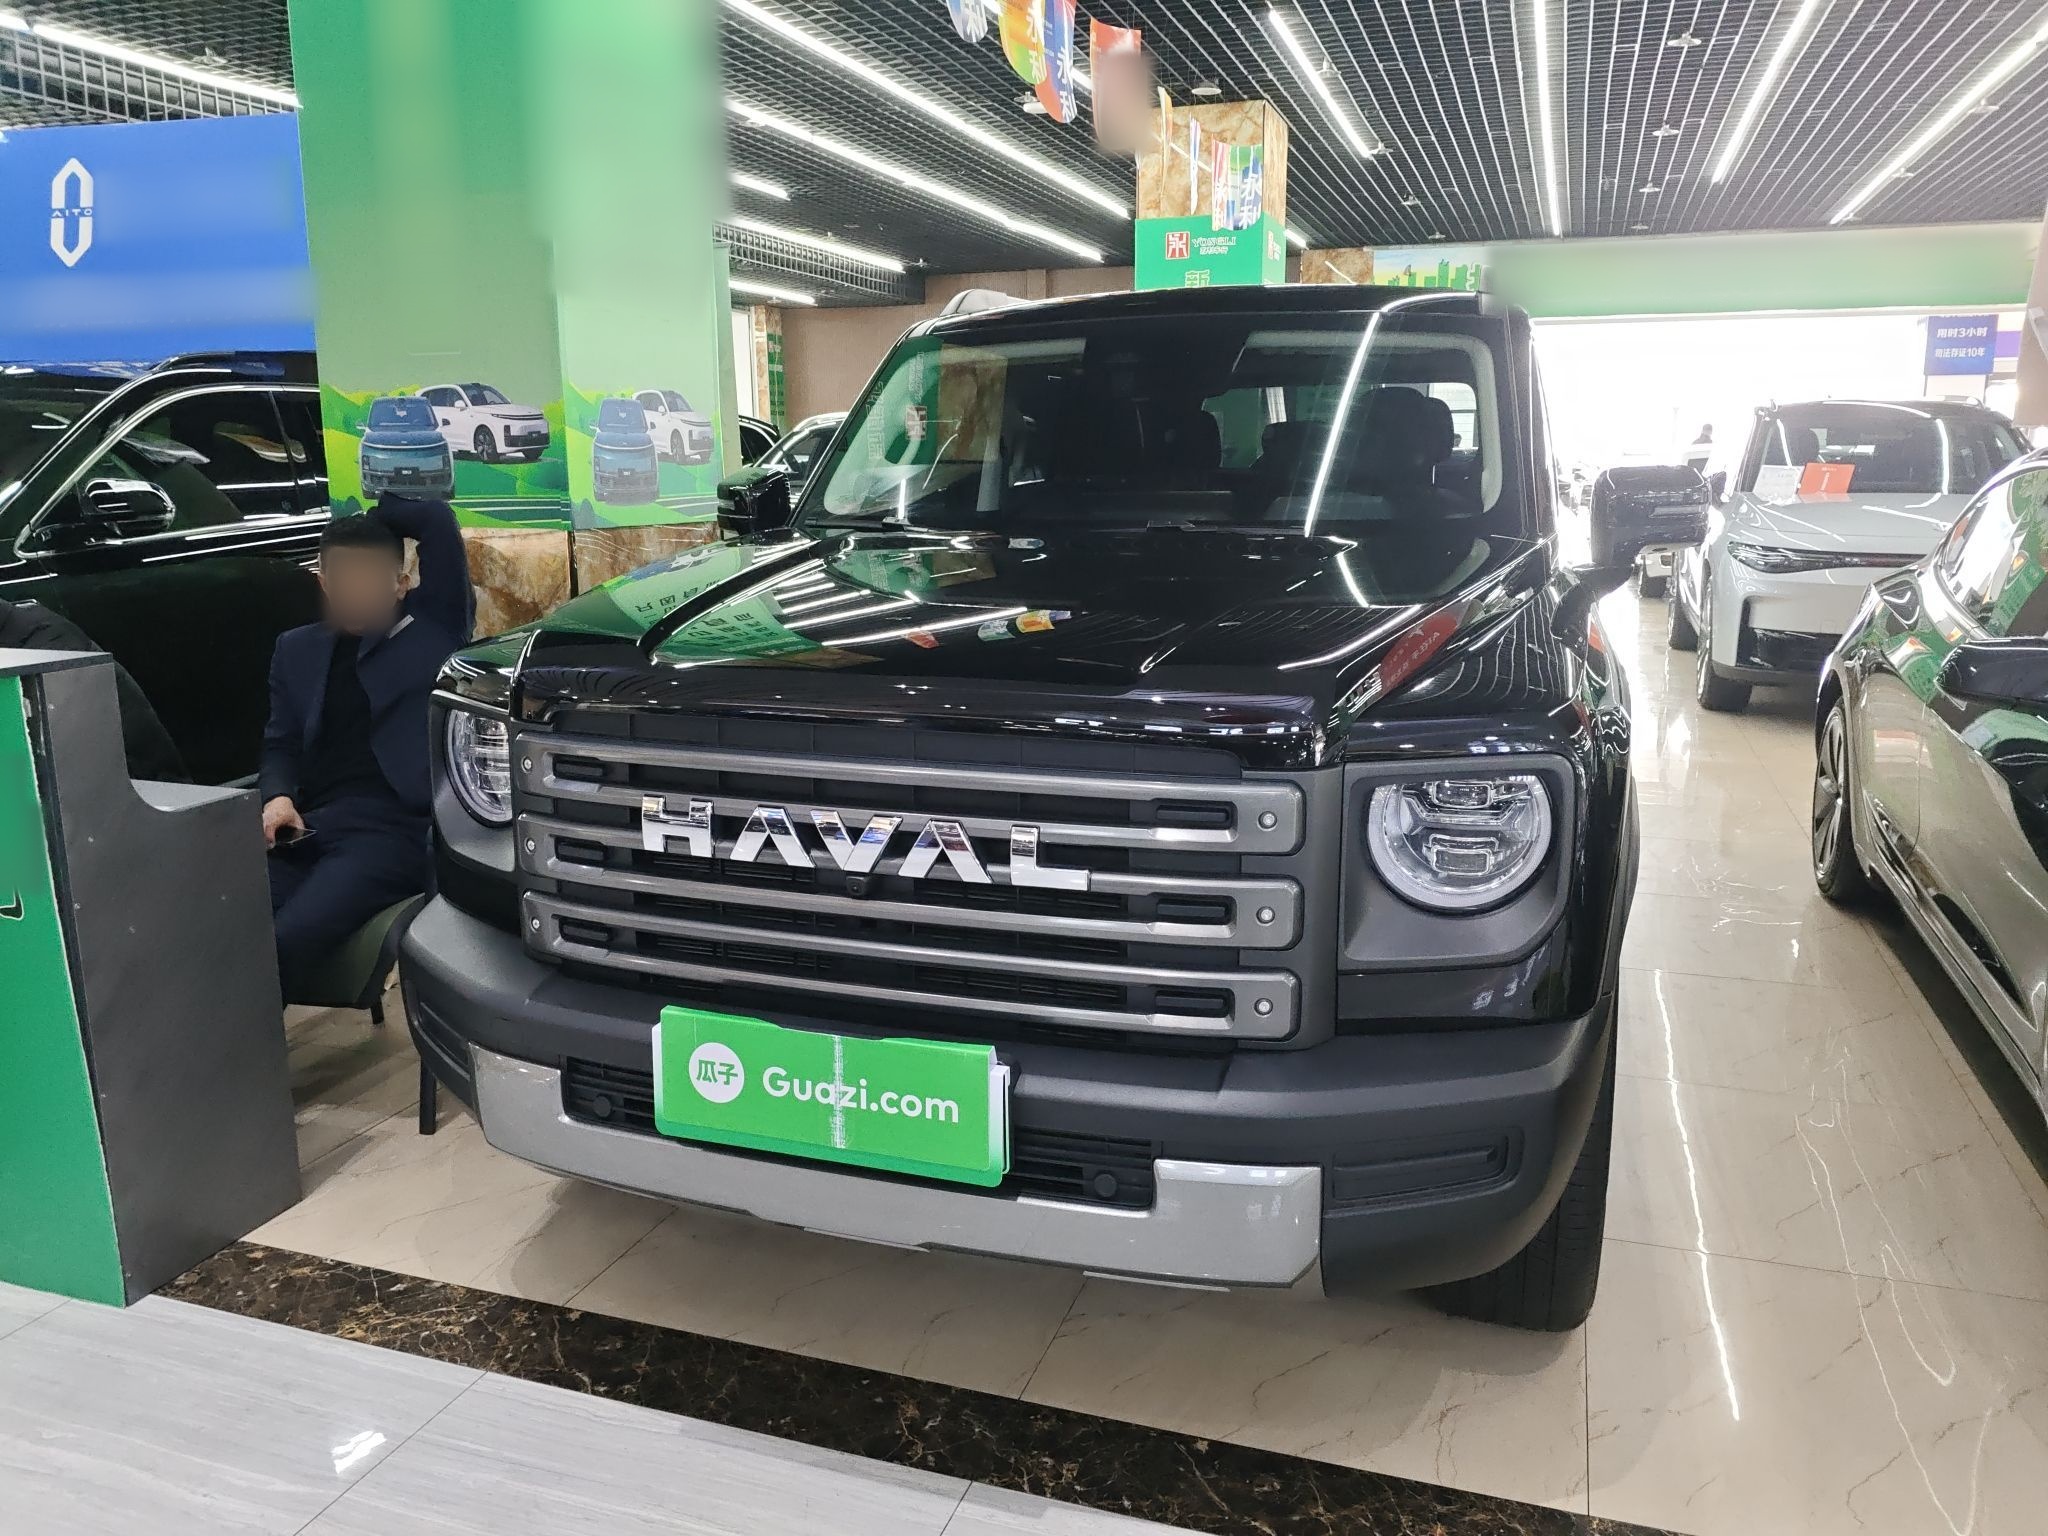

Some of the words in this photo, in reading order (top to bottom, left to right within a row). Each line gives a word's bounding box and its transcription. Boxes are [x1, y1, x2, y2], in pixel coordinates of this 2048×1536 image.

[52, 208, 93, 217] AITO
[1192, 236, 1236, 247] YONGLI
[641, 794, 1091, 891] HAVAL
[696, 1059, 738, 1086] 瓜子
[762, 1066, 959, 1123] Guazi.com
